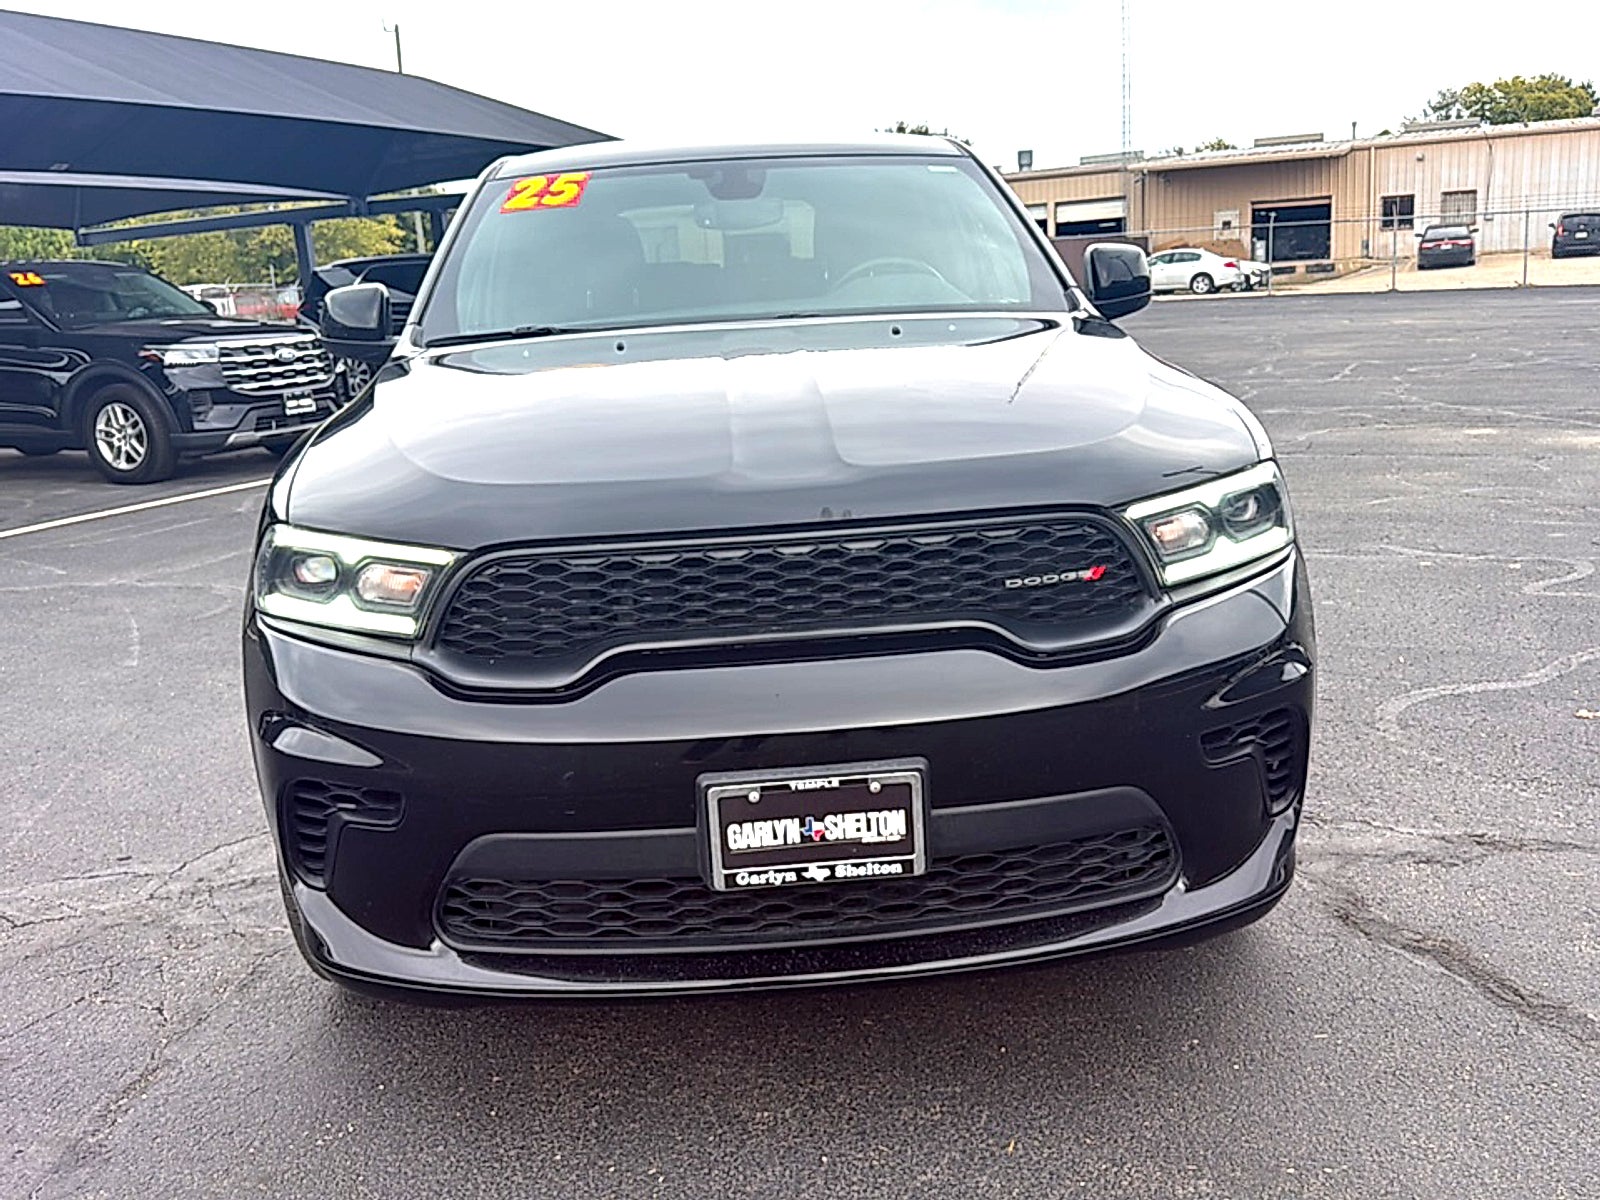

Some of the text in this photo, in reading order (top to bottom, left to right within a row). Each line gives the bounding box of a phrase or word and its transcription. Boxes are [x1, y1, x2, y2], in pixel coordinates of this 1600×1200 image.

[503, 172, 587, 209] 25
[1005, 569, 1092, 589] DODGE
[727, 809, 907, 850] GARLYN SHELTON
[735, 862, 903, 886] Garlyn Shelton
